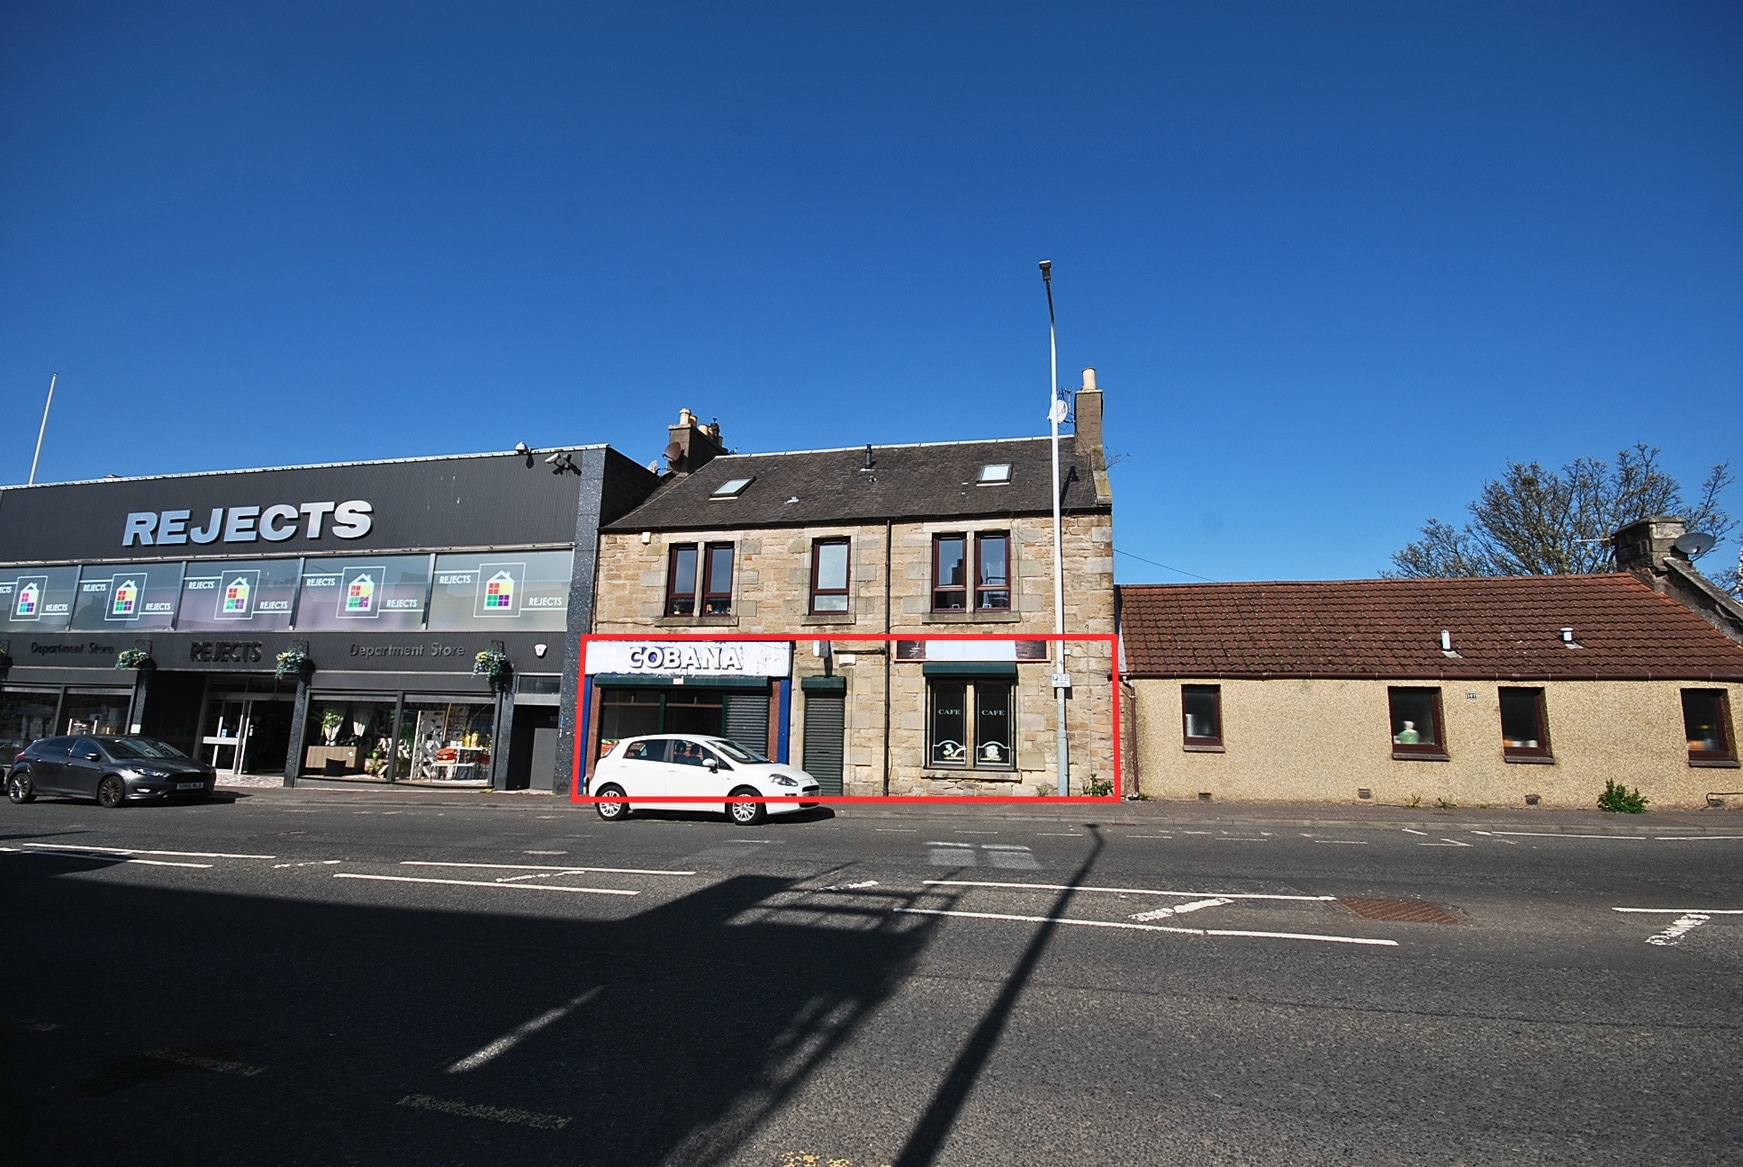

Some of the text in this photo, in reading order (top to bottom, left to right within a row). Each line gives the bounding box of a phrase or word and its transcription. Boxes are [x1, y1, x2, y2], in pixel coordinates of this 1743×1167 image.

[122, 500, 373, 546] REJECTS
[306, 578, 336, 587] REJECTS
[439, 575, 471, 584] REJECTS
[83, 583, 107, 592] REJECTS
[188, 581, 215, 590] REJECTS
[260, 601, 288, 610] REJECTS
[386, 599, 418, 608] REJECTS
[528, 597, 563, 606] REJECTS
[45, 603, 68, 612] REJECTS
[145, 602, 171, 611] REJECTS
[31, 642, 114, 655] Department Store
[189, 641, 262, 663] REJECTS
[350, 642, 465, 657] Department Store
[630, 647, 743, 671] COBANA
